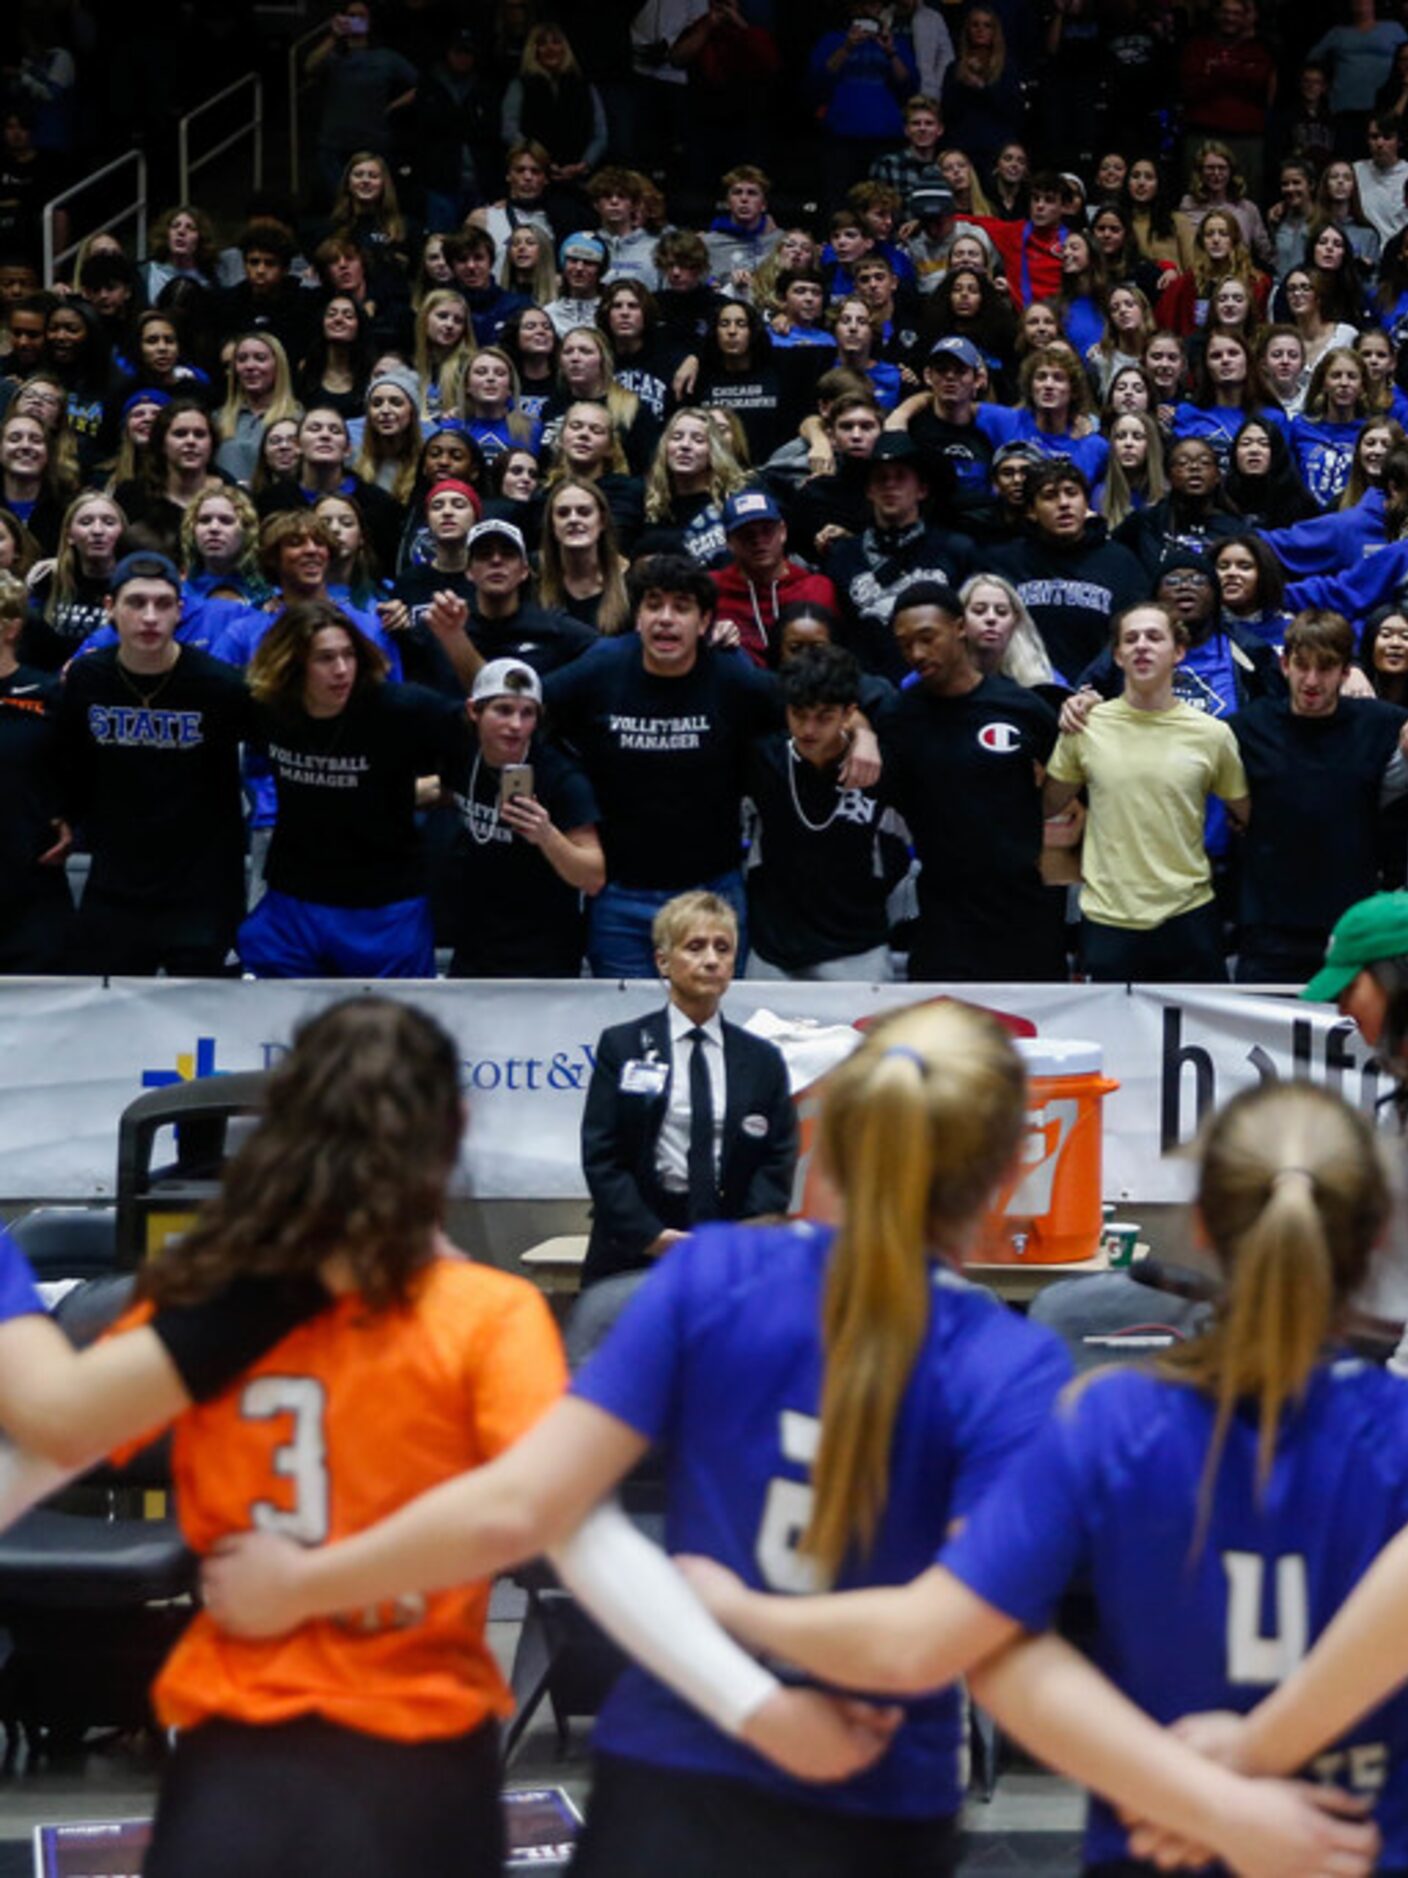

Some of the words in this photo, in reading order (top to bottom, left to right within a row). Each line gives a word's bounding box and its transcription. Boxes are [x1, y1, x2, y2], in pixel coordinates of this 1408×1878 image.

[88, 704, 204, 743] STATE
[610, 714, 711, 733] VOLLEYBALL
[620, 734, 700, 749] MANAGER
[268, 743, 370, 771] VOLLEYBALL
[279, 765, 359, 788] MANAGER
[241, 1375, 330, 1548] 3
